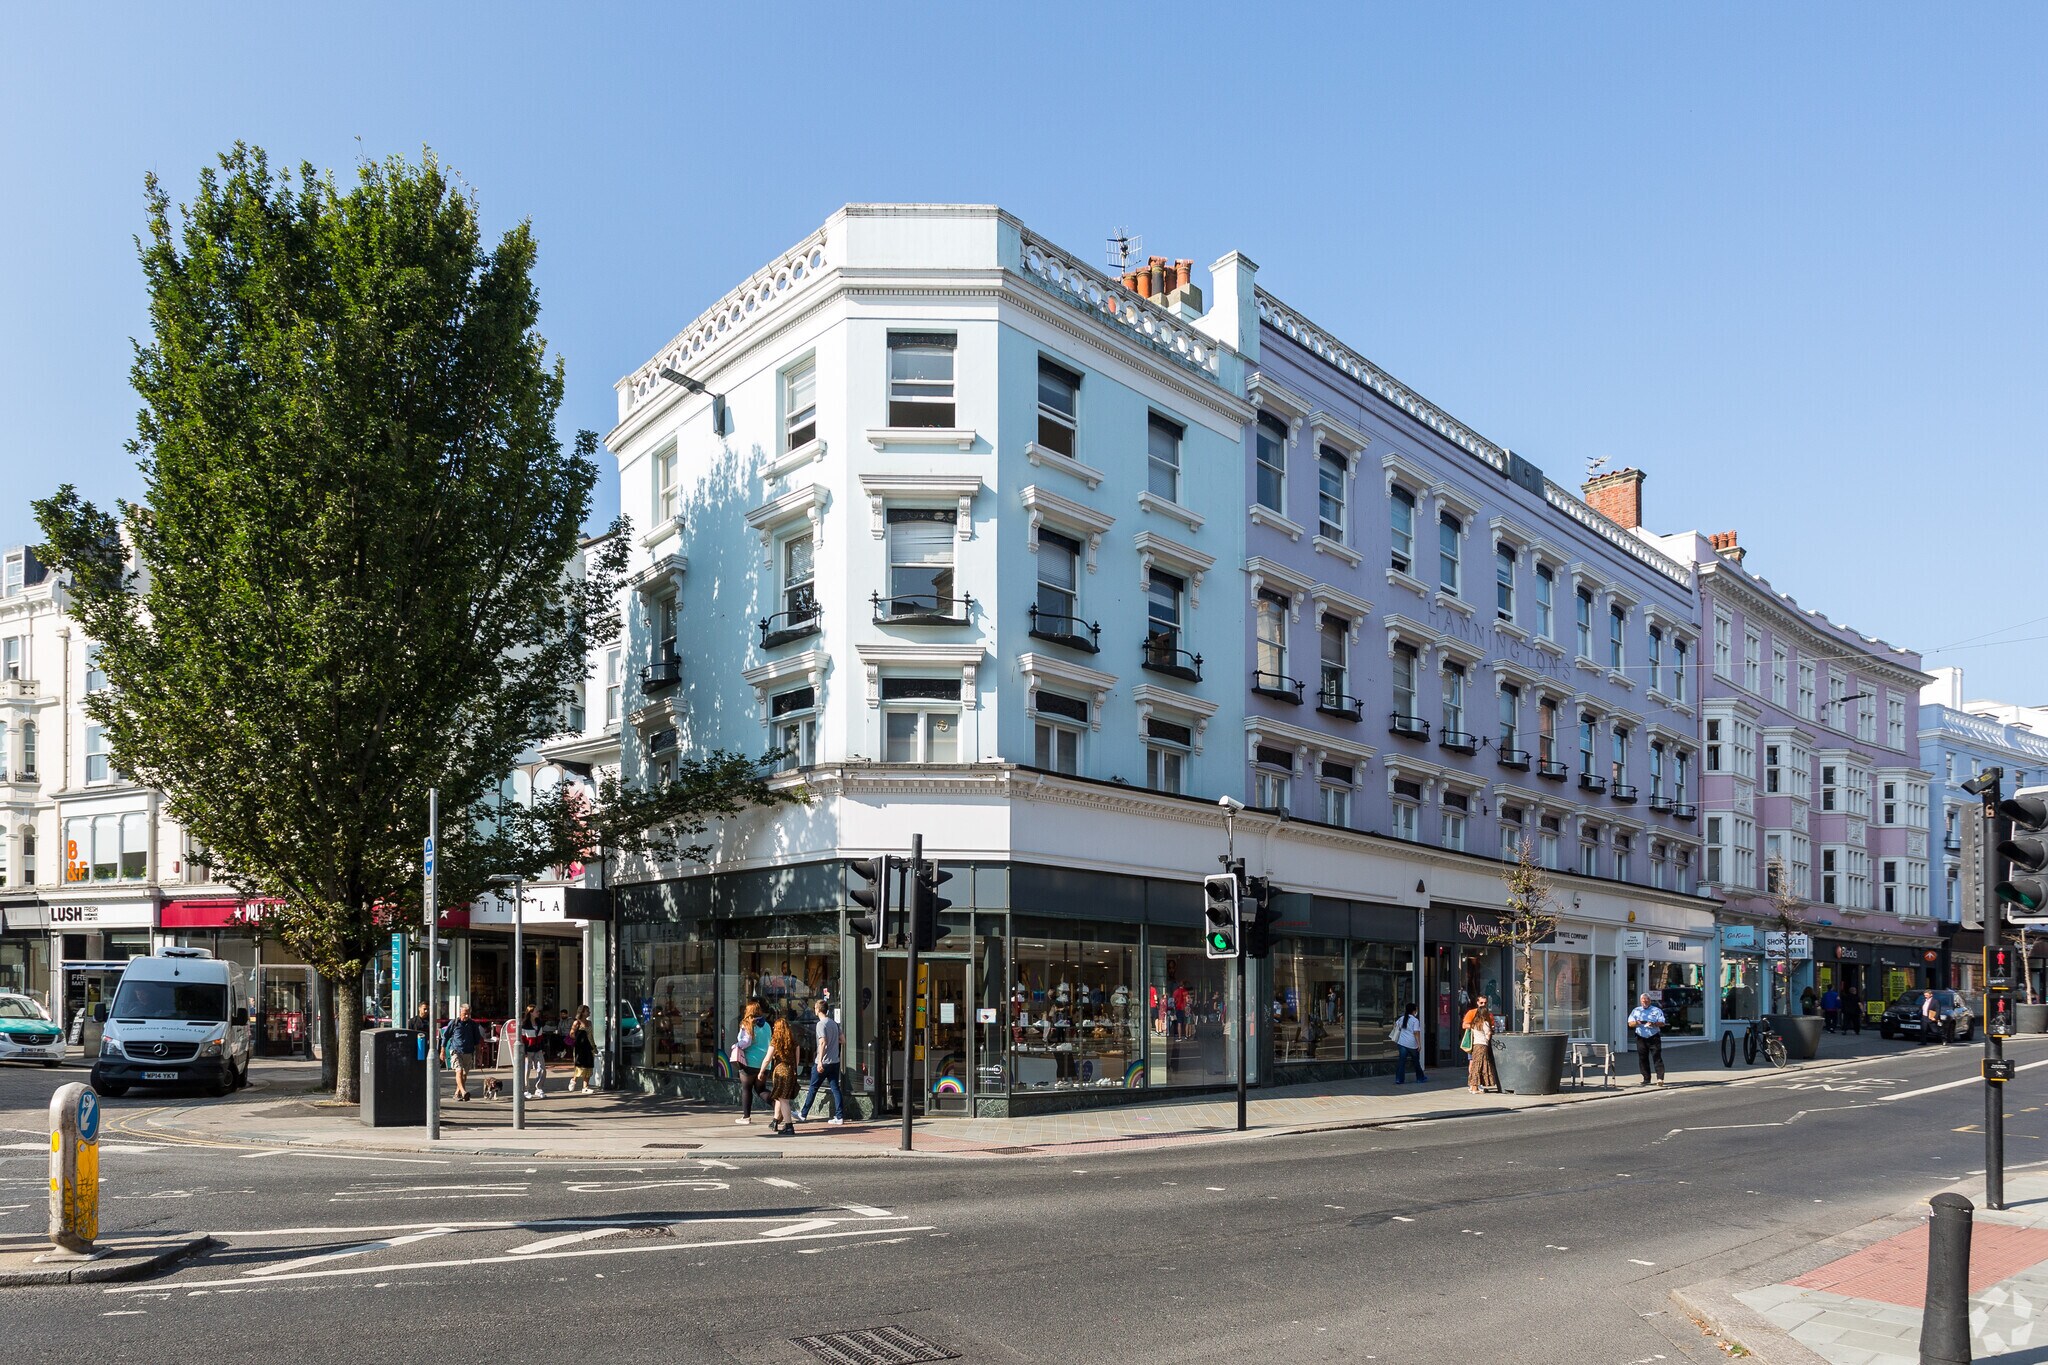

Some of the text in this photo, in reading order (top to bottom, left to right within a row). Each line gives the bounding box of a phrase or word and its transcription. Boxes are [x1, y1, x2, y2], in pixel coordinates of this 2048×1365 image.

[1427, 601, 1571, 680] HANNINGTONS
[50, 906, 82, 922] LUSH
[1841, 946, 1858, 959] Blacks
